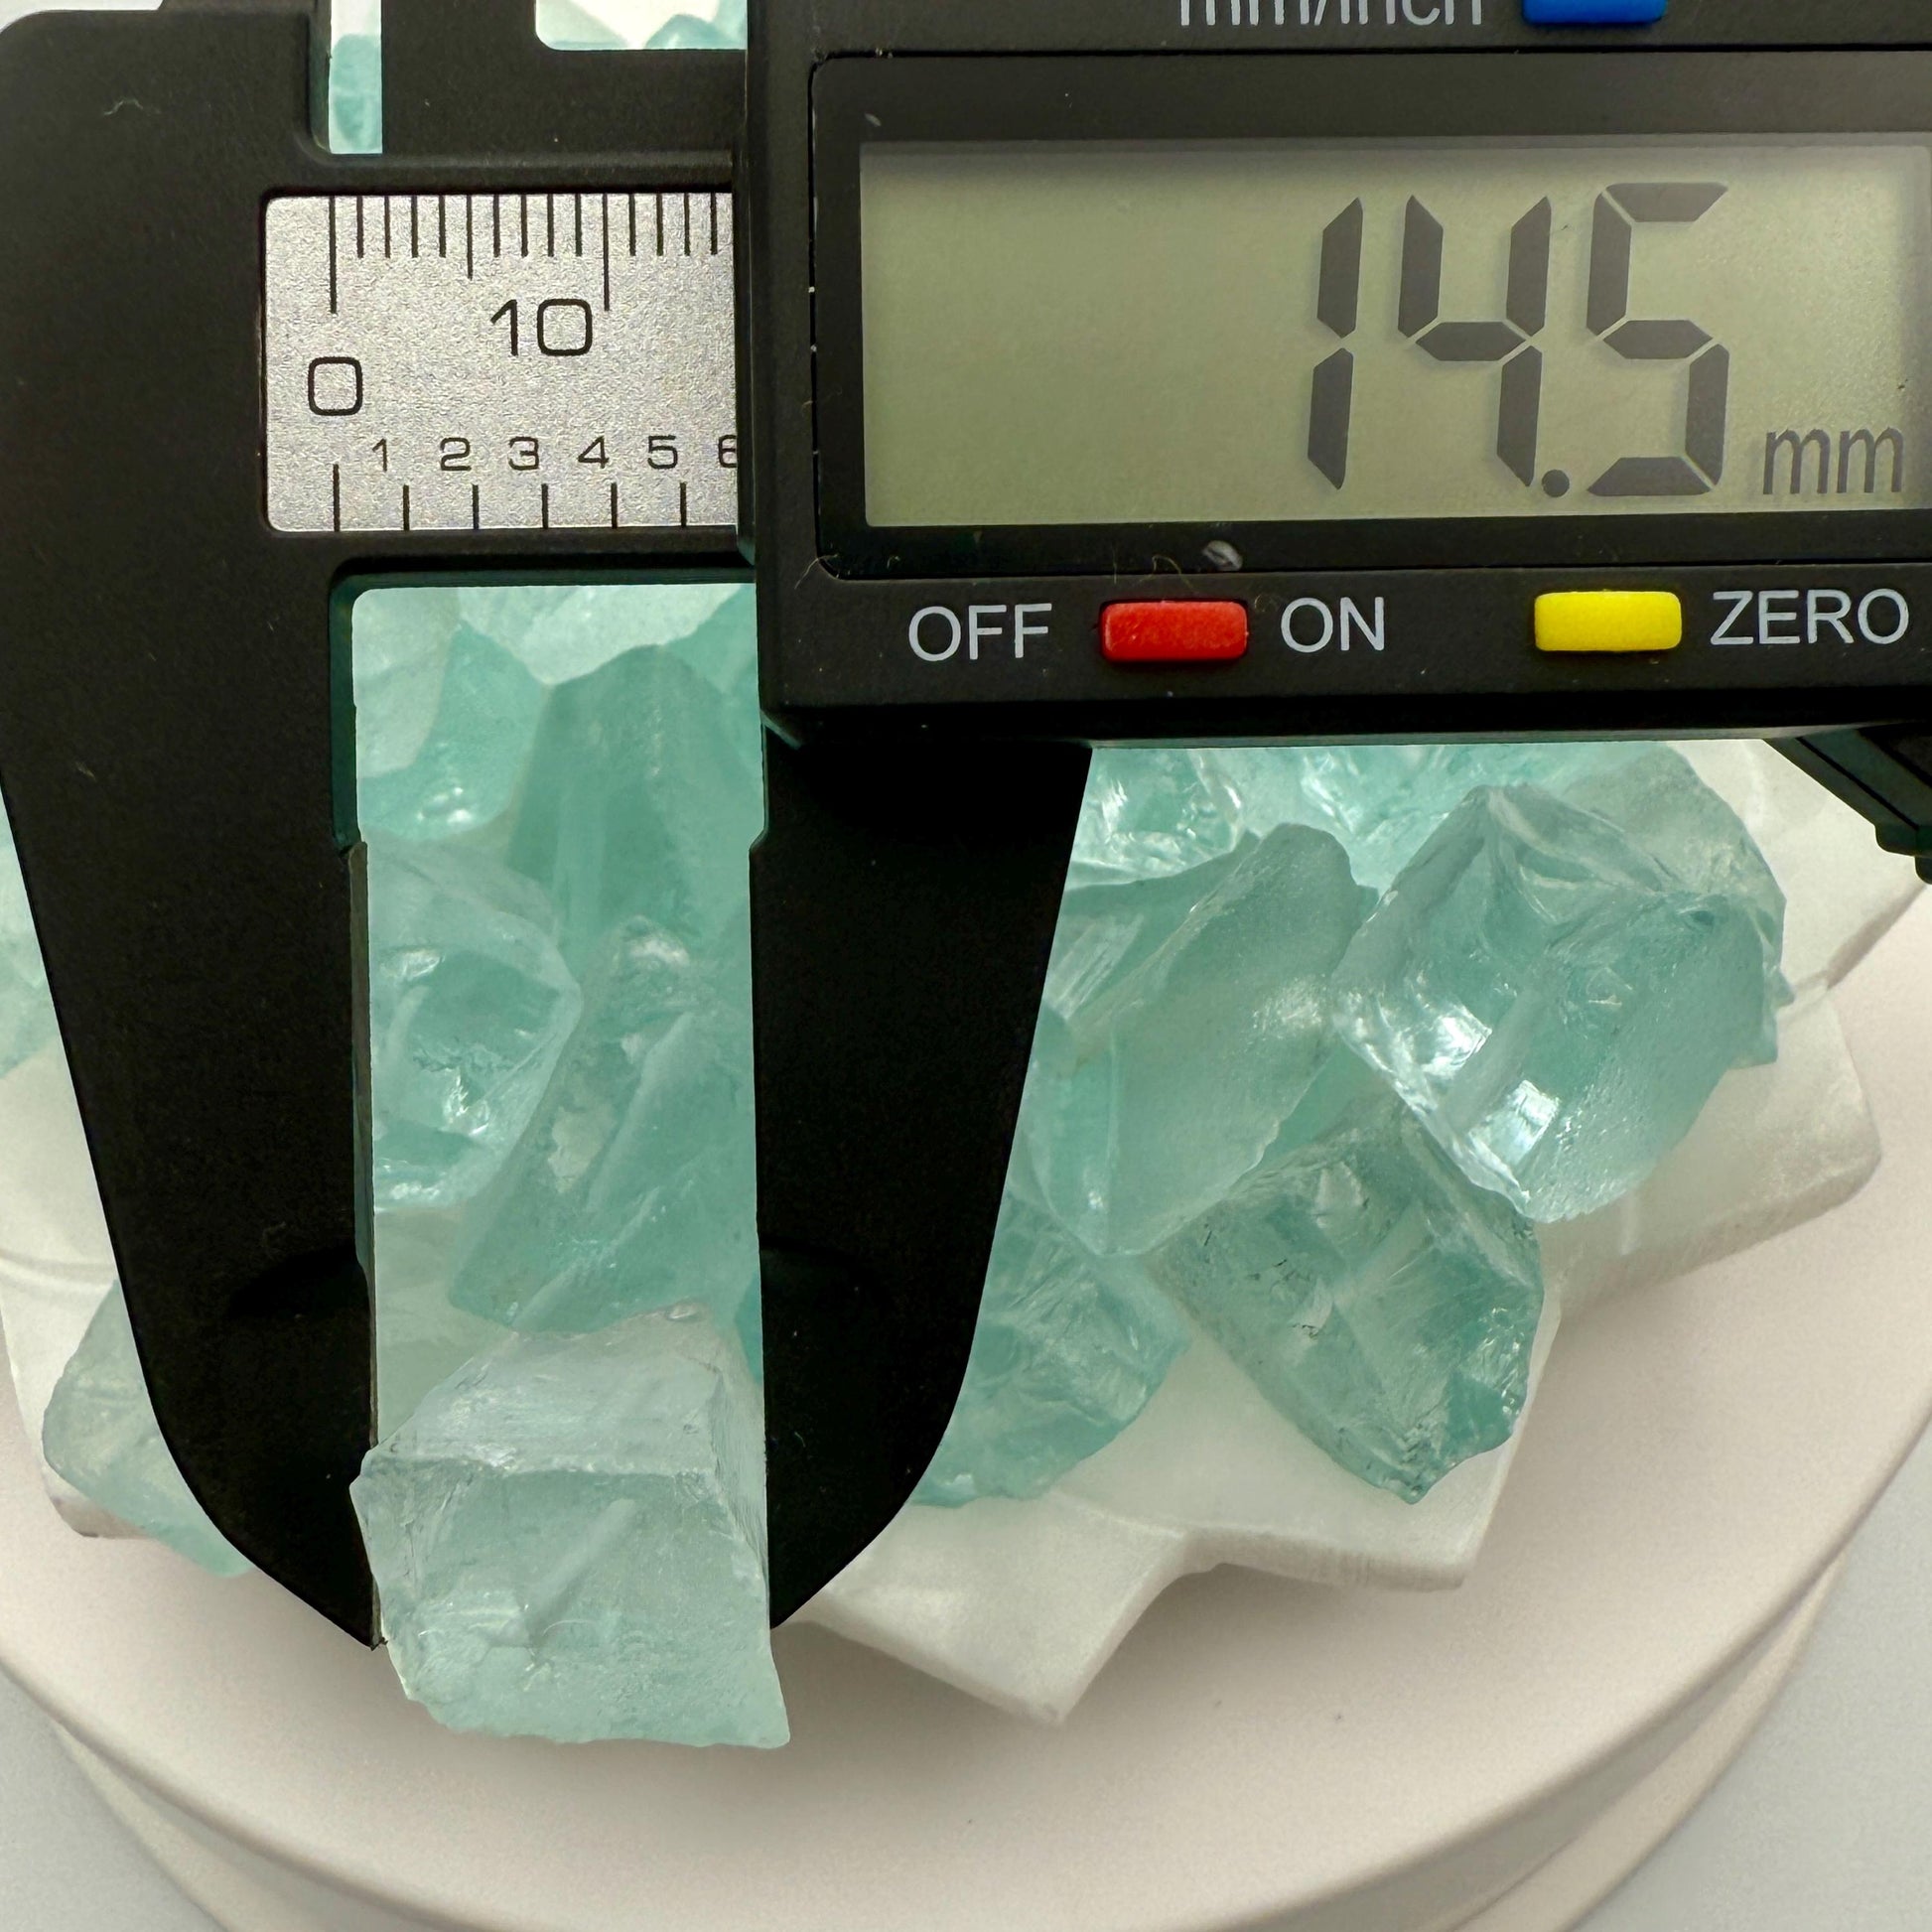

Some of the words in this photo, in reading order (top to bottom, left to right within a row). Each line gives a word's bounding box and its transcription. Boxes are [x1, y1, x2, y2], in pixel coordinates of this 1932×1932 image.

[489, 298, 594, 356] 10
[1306, 182, 1730, 495] 14.5
[1762, 427, 1905, 495] mm
[307, 355, 363, 416] 0
[371, 438, 388, 472] 1
[439, 436, 472, 472] 2
[507, 436, 540, 471] 3
[577, 435, 610, 470] 4
[647, 434, 678, 470] 5
[908, 603, 1052, 662] OFF
[1280, 596, 1385, 653] ON
[1710, 588, 1910, 645] ZERO
